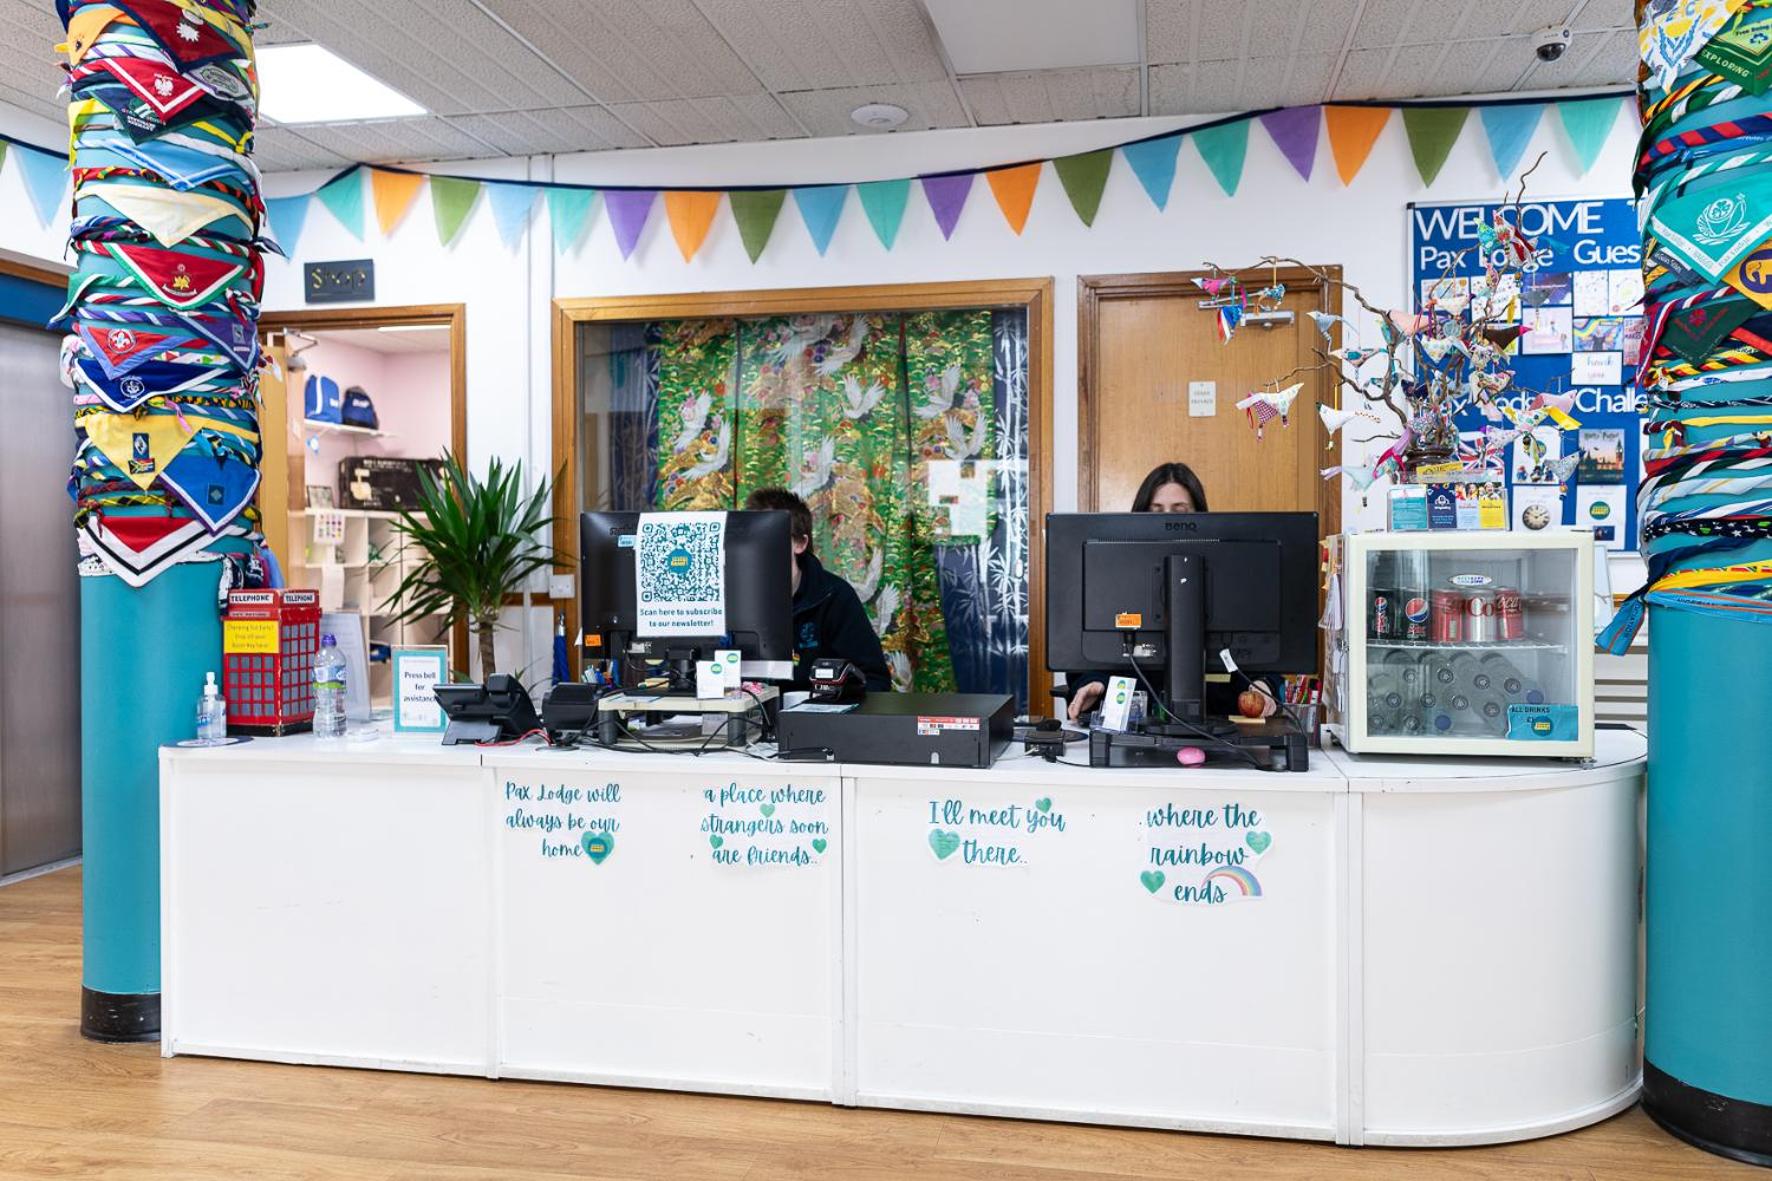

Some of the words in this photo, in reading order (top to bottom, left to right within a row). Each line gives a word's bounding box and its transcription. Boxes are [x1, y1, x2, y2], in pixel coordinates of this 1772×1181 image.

[1701, 49, 1750, 77] EXPLORING
[1421, 246, 1466, 270] Pax
[1479, 244, 1554, 273] Loge
[1574, 239, 1641, 264] Gues
[231, 594, 269, 602] TELEPHONE
[286, 594, 313, 602] TELEPHONE
[640, 608, 657, 616] Scan
[659, 608, 675, 616] here
[685, 607, 723, 616] subscribe
[671, 619, 714, 627] newsletter!
[404, 671, 422, 679] Press
[423, 671, 436, 679] bell
[506, 781, 531, 801] Pax
[537, 784, 582, 805] Lodge
[587, 783, 621, 802] will
[703, 789, 716, 802] a
[720, 782, 766, 807] place
[771, 784, 826, 805] where
[506, 808, 562, 832] always
[568, 813, 586, 830] be
[590, 818, 620, 833] our
[701, 814, 784, 836] strangers
[790, 820, 829, 834] soon
[929, 800, 964, 825] I'll
[969, 804, 1023, 828] meet
[1026, 809, 1066, 833] you
[1147, 803, 1219, 828] where
[1222, 804, 1261, 828] the
[542, 838, 582, 857] home
[712, 848, 741, 864] are
[1151, 843, 1249, 866] rainbow
[1174, 880, 1227, 904] ends
